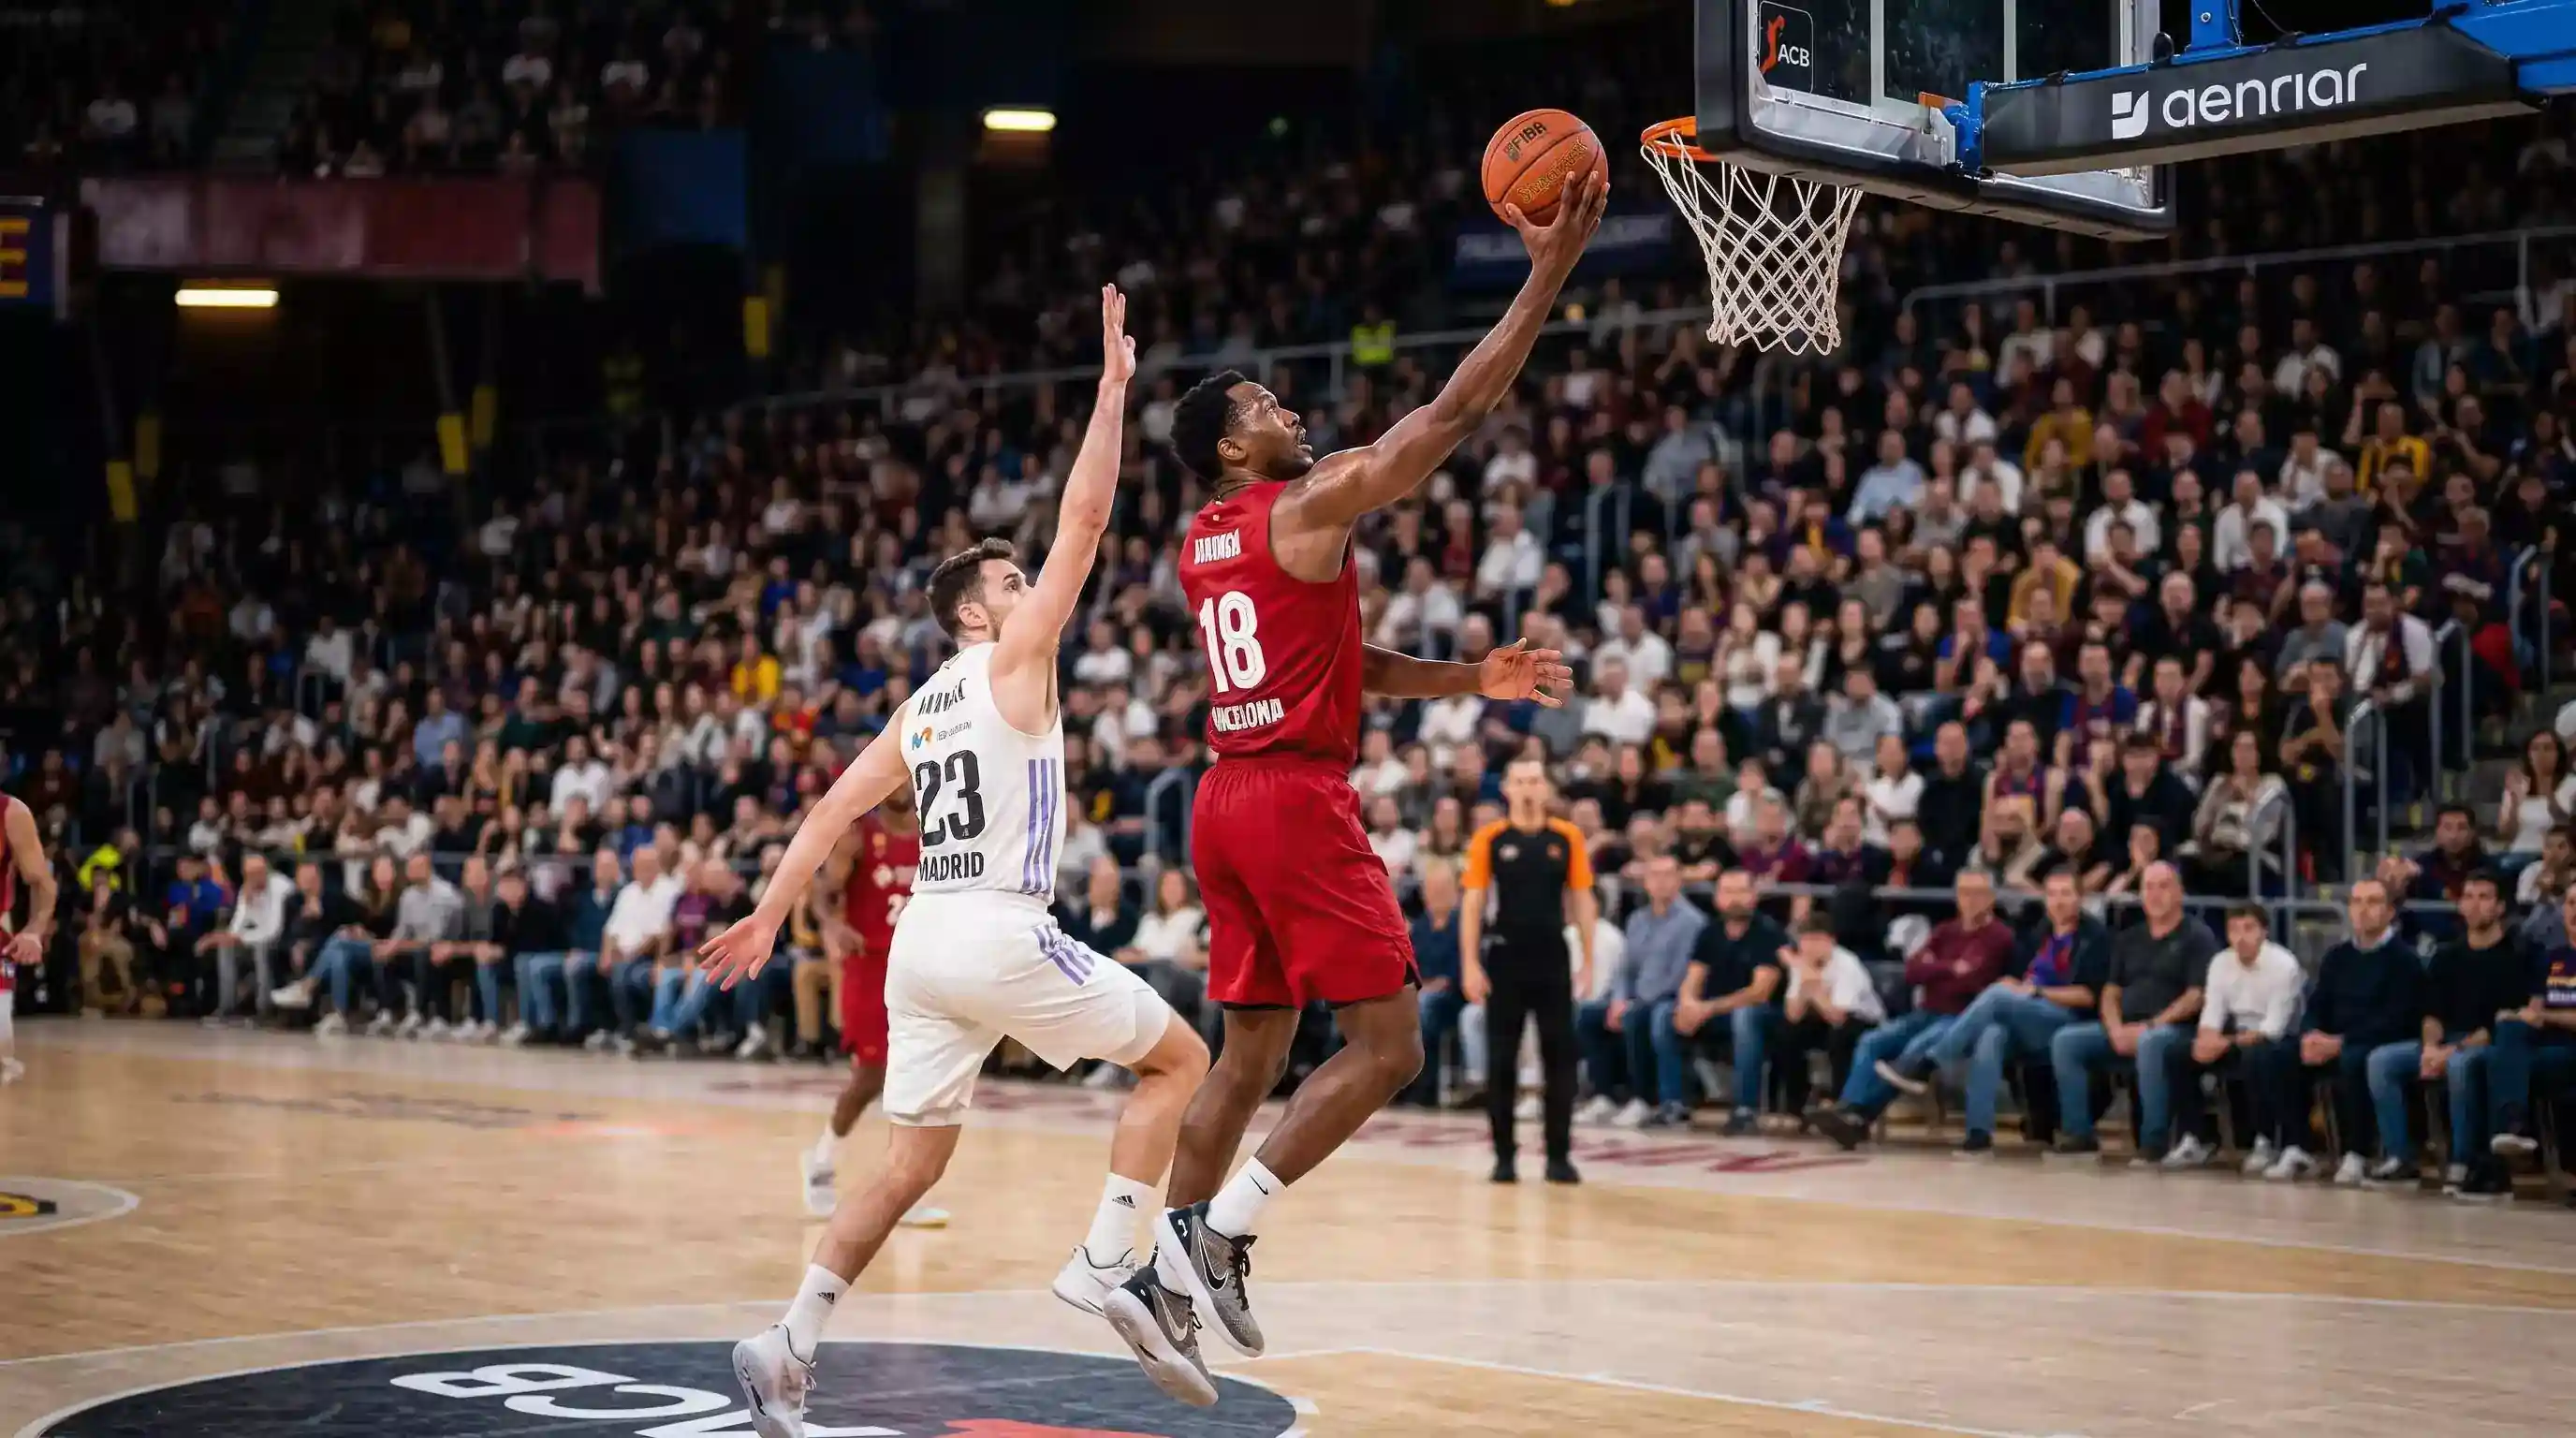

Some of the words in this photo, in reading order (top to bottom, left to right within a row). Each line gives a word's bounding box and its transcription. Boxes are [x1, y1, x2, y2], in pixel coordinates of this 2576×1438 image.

[1778, 43, 1810, 67] ACB
[1511, 122, 1547, 152] FIBA
[1199, 591, 1266, 693] 18
[915, 749, 986, 846] 23
[919, 851, 985, 882] MADRID
